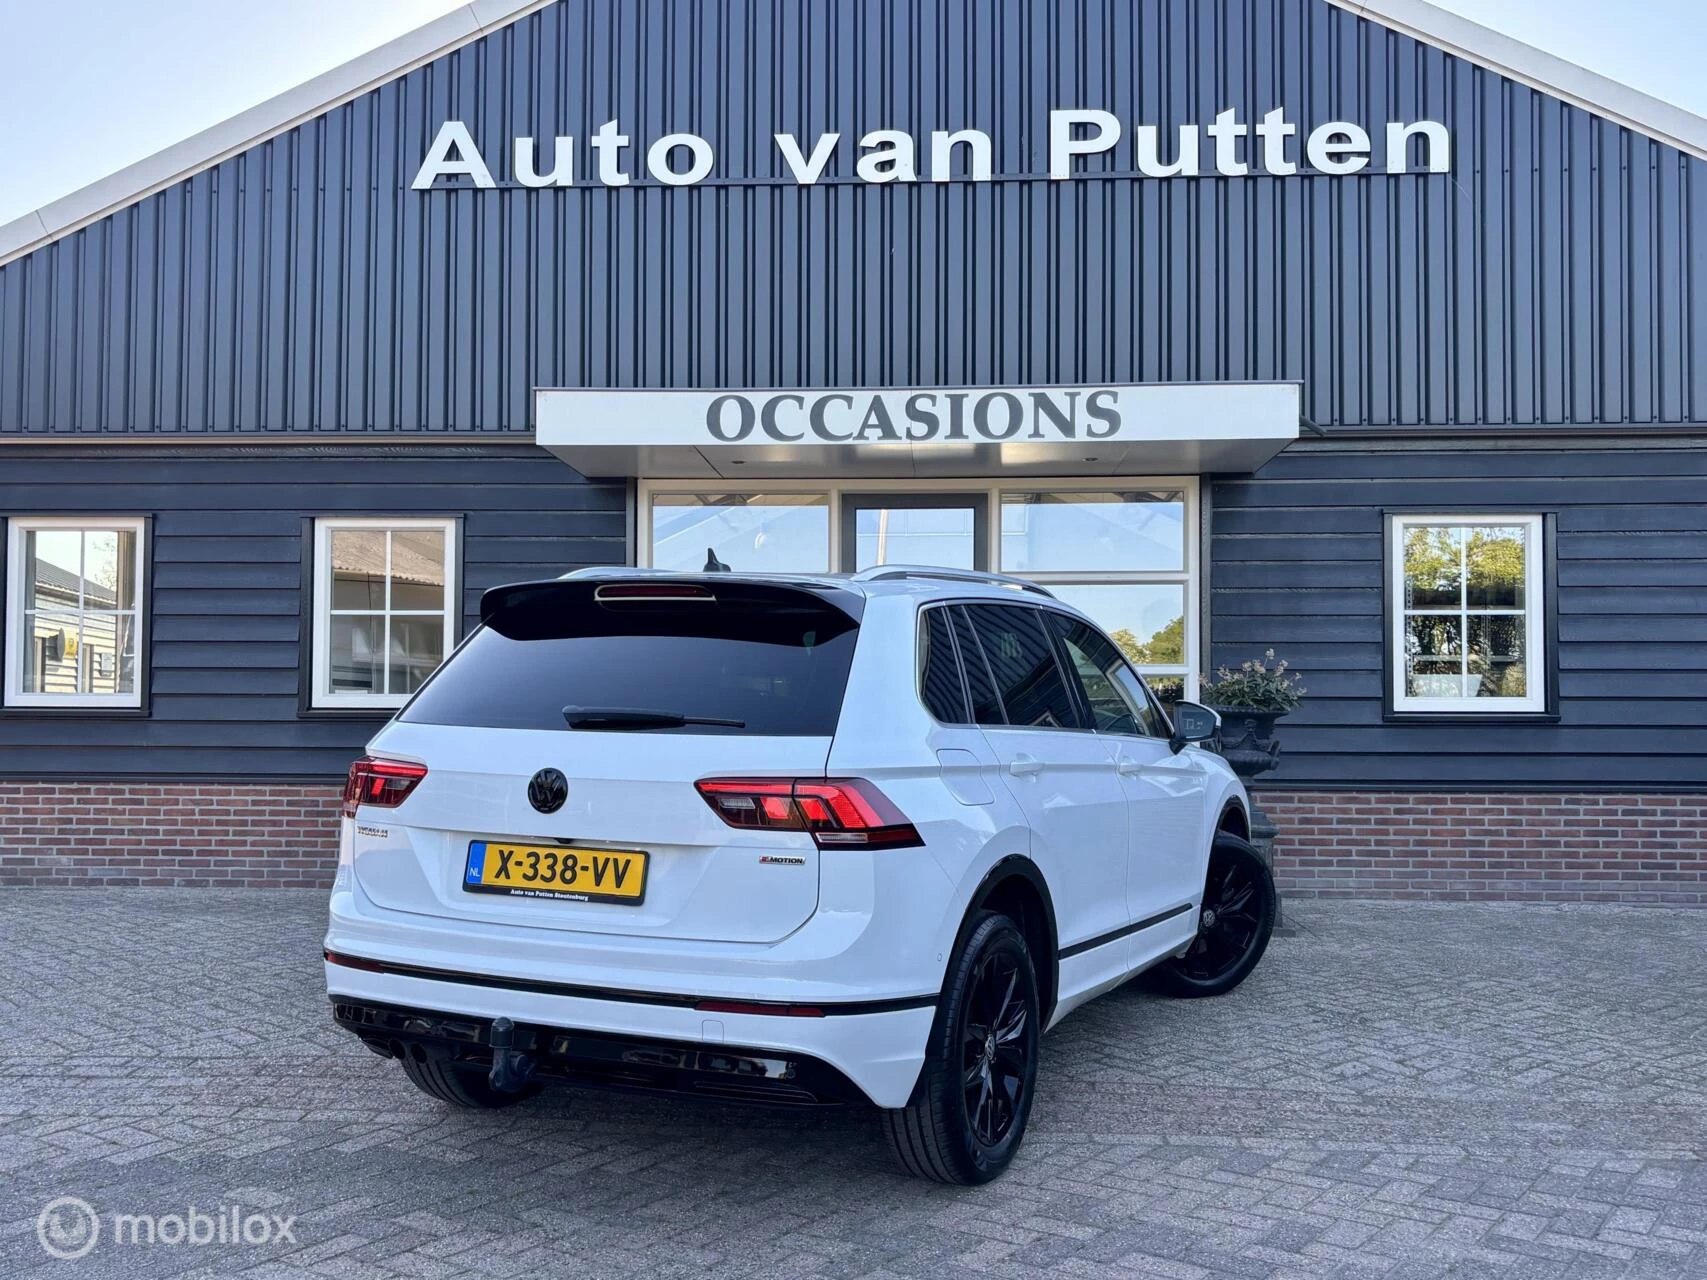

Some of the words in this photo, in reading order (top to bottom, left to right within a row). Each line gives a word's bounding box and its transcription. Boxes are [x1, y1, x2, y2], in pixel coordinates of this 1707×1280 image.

[411, 119, 714, 190] Auto
[774, 127, 992, 185] van
[1050, 106, 1450, 180] Putten
[706, 389, 1122, 442] OCCASIONS
[469, 867, 481, 878] NL
[494, 849, 632, 889] X-338-VV
